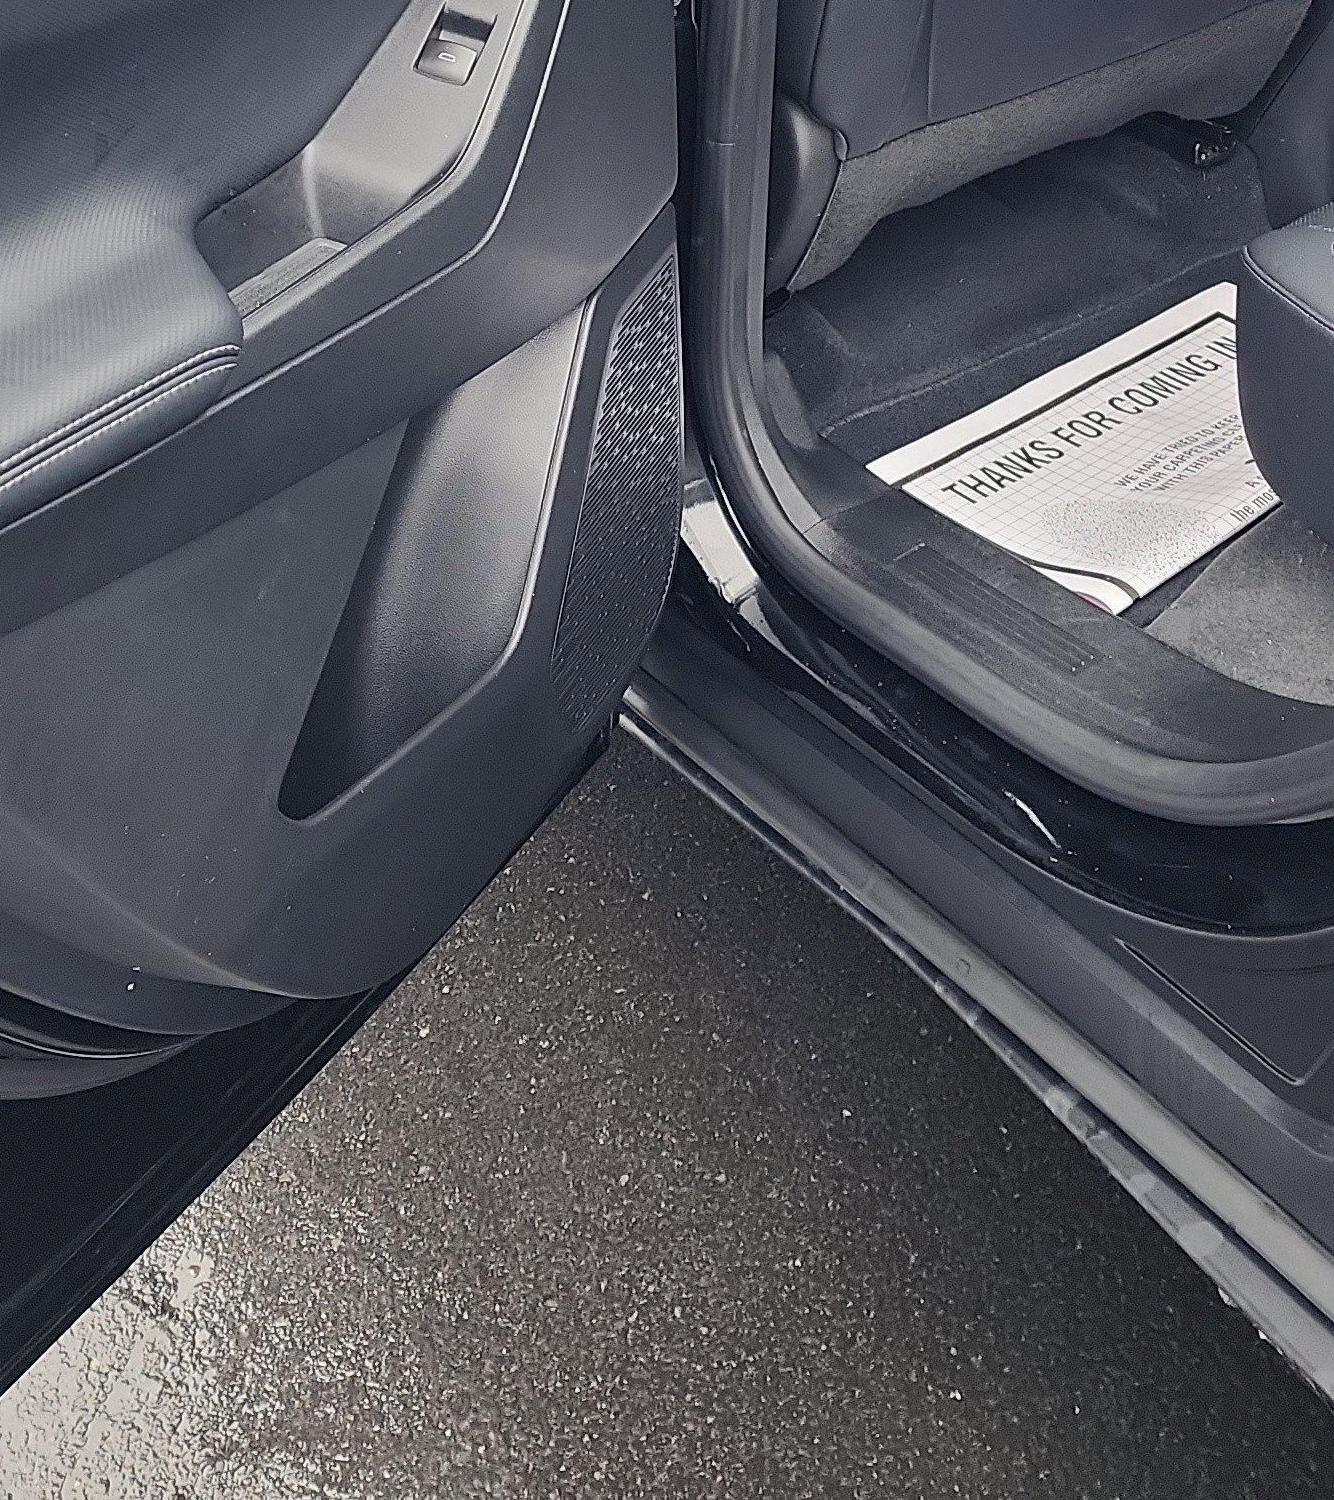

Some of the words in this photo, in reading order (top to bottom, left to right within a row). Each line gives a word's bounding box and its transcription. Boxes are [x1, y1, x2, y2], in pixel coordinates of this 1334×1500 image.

[941, 439, 1065, 504] THANKS
[1052, 410, 1123, 448] FOR
[1108, 354, 1223, 415] COMING
[1114, 472, 1139, 487] WE
[1133, 451, 1168, 475] HAVE
[1164, 435, 1197, 455] TRIED
[1195, 429, 1215, 440] TO
[1130, 471, 1167, 492] YOUR
[1164, 437, 1226, 472] CARPETING
[1152, 471, 1188, 492] WITH
[1183, 454, 1215, 476] THIS
[1209, 435, 1245, 457] PAPER
[1229, 505, 1255, 522] the
